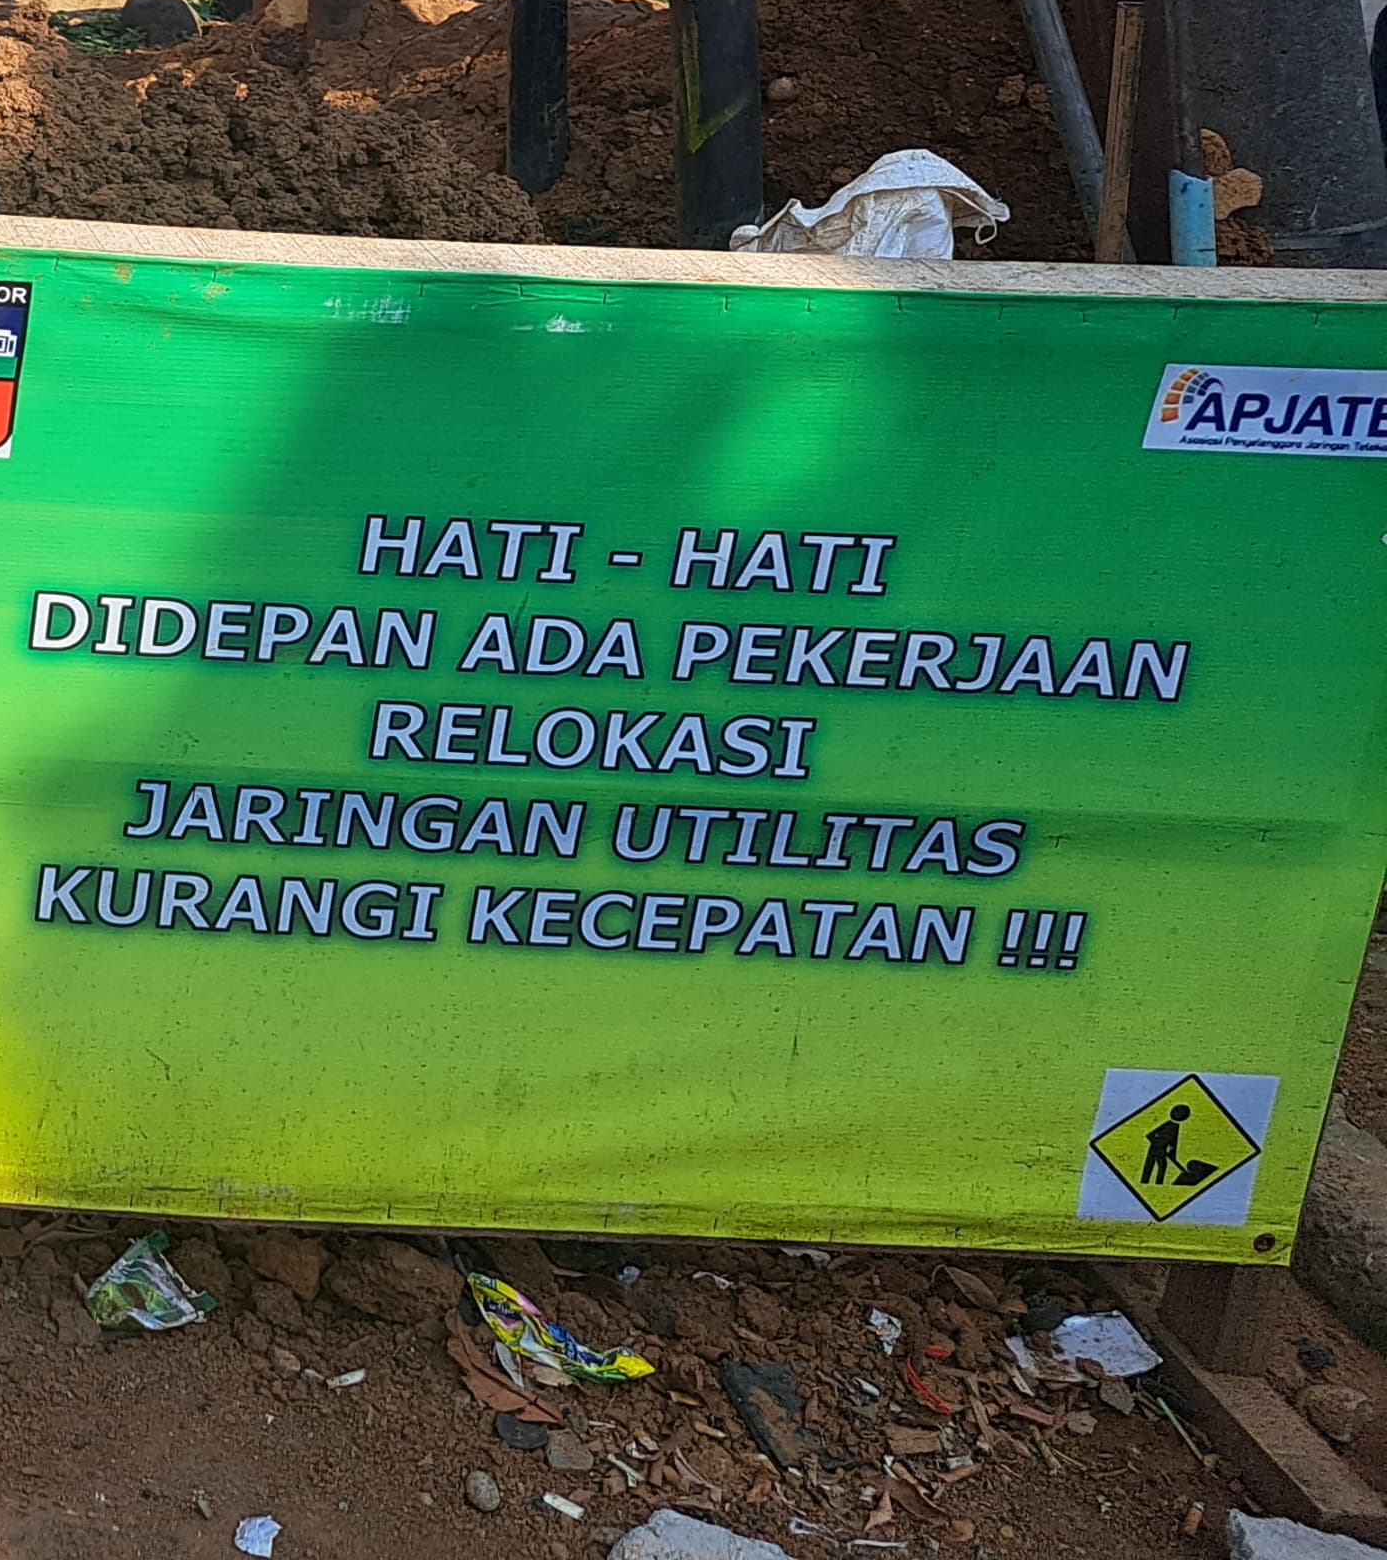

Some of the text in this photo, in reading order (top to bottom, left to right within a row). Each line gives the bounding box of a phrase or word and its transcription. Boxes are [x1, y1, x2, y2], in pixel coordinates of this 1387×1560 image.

[358, 514, 898, 597] HATI - HATI
[28, 590, 1192, 703] DIDEPAN ADA PEKERJAAN
[368, 700, 817, 780] RELOKASI
[123, 778, 1026, 878] JARINGAN UTILITAS
[34, 863, 1089, 972] KURANGI KECEPATAN !!!
